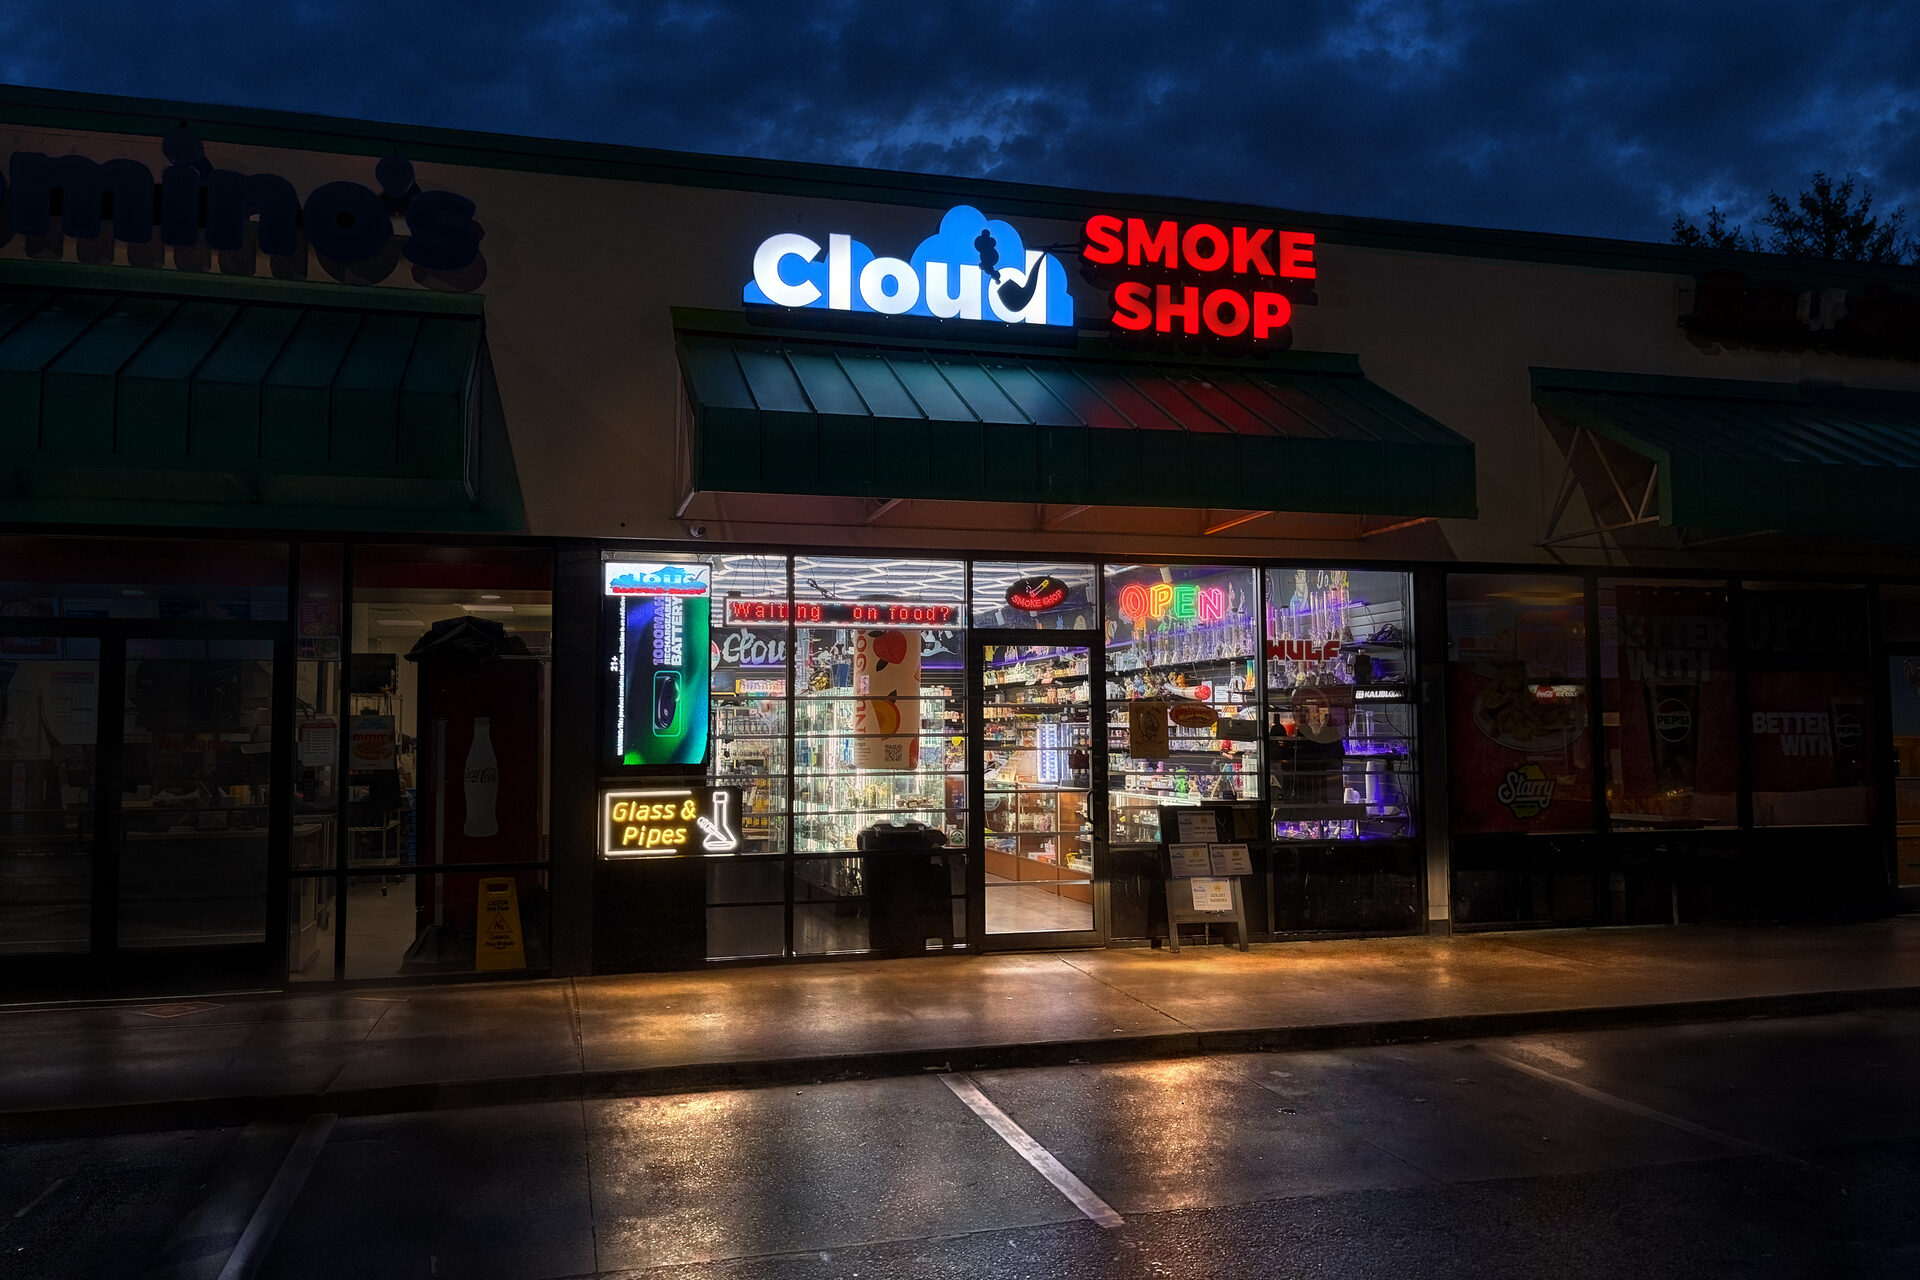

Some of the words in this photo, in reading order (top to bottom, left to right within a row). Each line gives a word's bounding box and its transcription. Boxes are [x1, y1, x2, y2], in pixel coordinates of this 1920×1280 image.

[0, 127, 482, 272] mino's
[1082, 214, 1318, 280] SMOKE
[752, 232, 1048, 326] Cloud
[1110, 281, 1293, 340] SHOP
[731, 601, 821, 622] Waitng
[853, 606, 877, 620] on
[889, 605, 951, 621] food?
[1010, 595, 1042, 608] SMOKE
[1042, 588, 1064, 606] SHOP
[1119, 583, 1225, 622] OPEN
[671, 596, 683, 666] BATTERY
[722, 628, 788, 664] Clou
[610, 655, 619, 672] 21+
[1656, 714, 1689, 725] PEPSI
[1752, 711, 1830, 734] BETTER
[1780, 734, 1833, 756] WITH
[1498, 769, 1557, 809] Starry
[612, 800, 677, 821] Glass
[680, 799, 697, 820] &
[621, 824, 688, 849] Pipes
